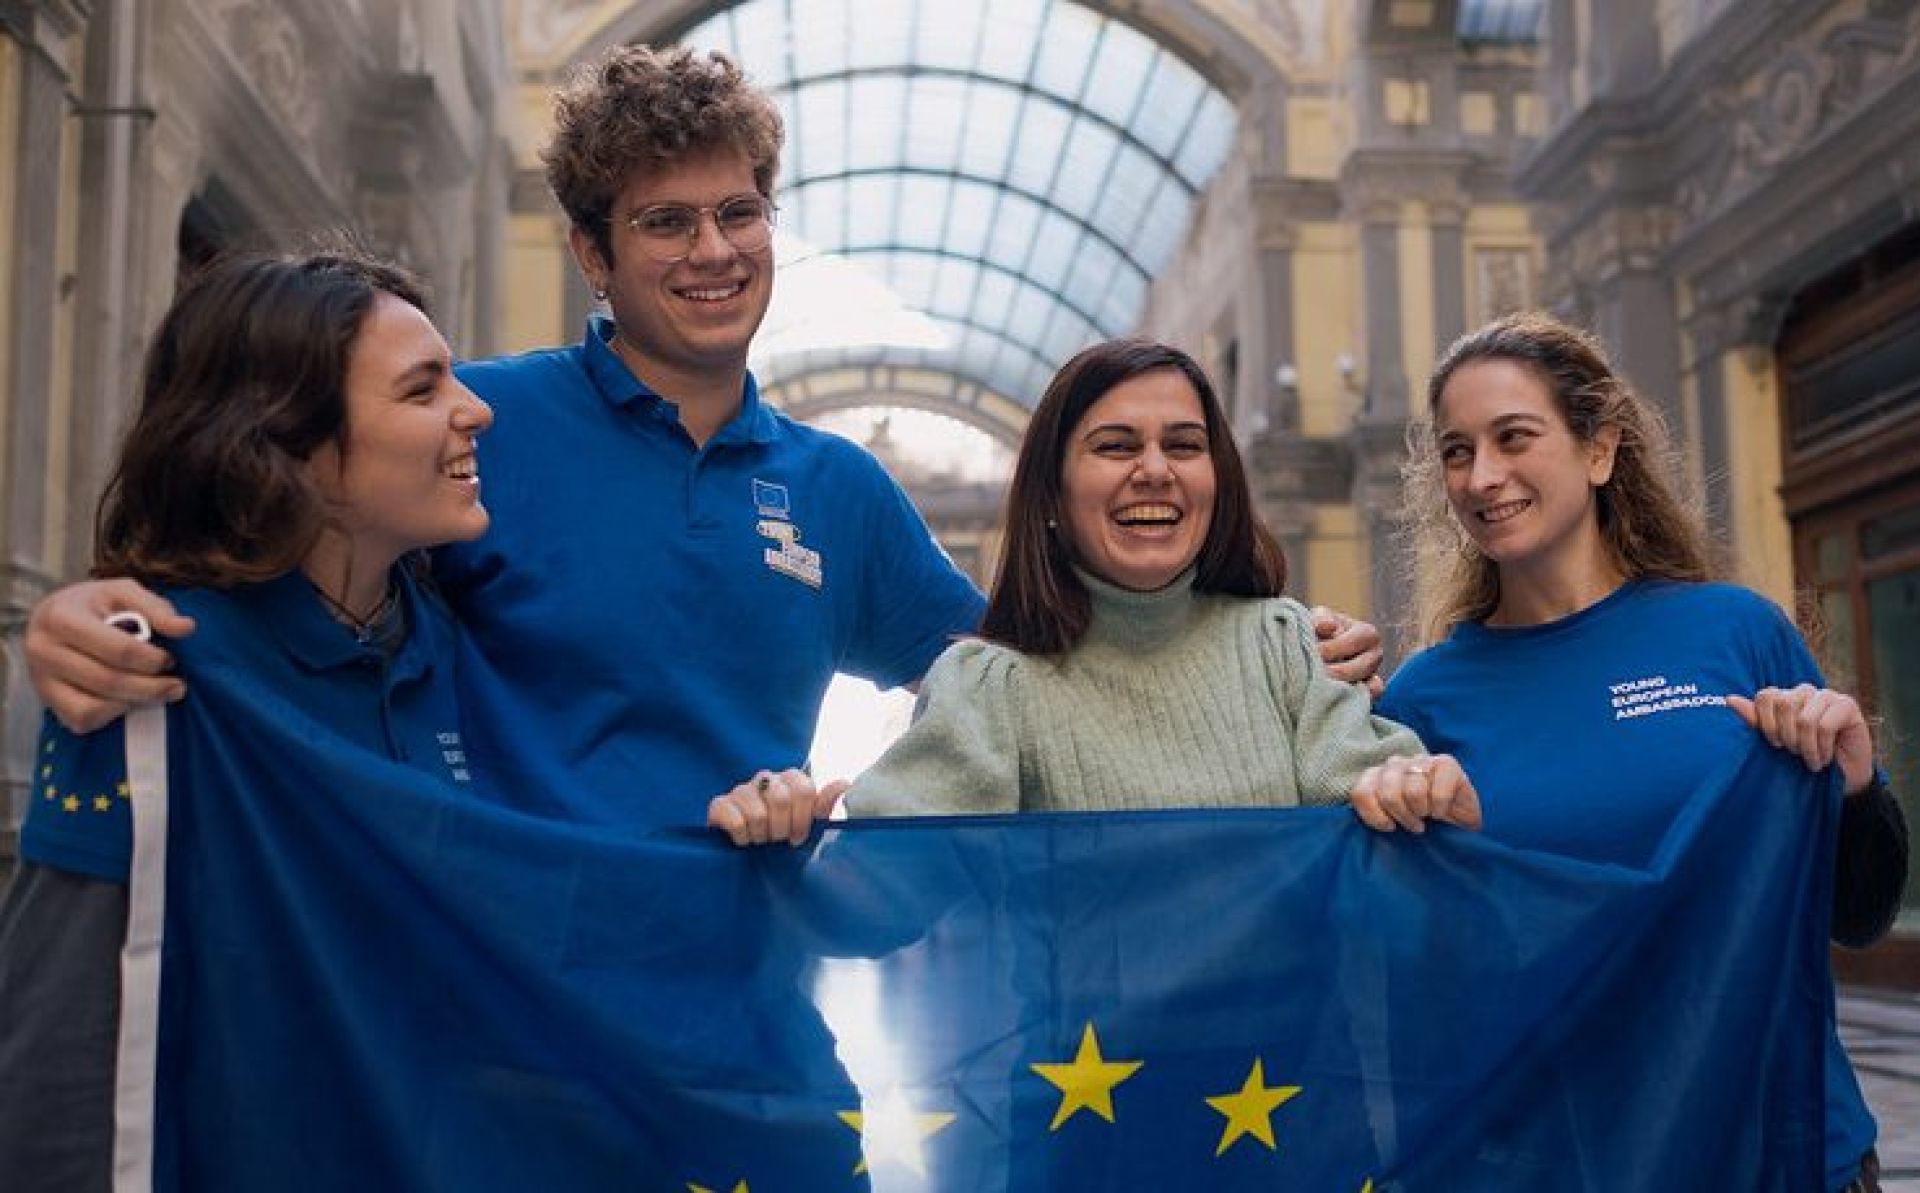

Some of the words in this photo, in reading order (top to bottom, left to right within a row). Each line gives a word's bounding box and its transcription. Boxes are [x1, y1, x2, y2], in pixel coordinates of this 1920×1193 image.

[1609, 676, 1666, 694] YOUNG
[1612, 684, 1698, 707] EUROPEAN
[1616, 695, 1726, 720] AMBASSADOR
